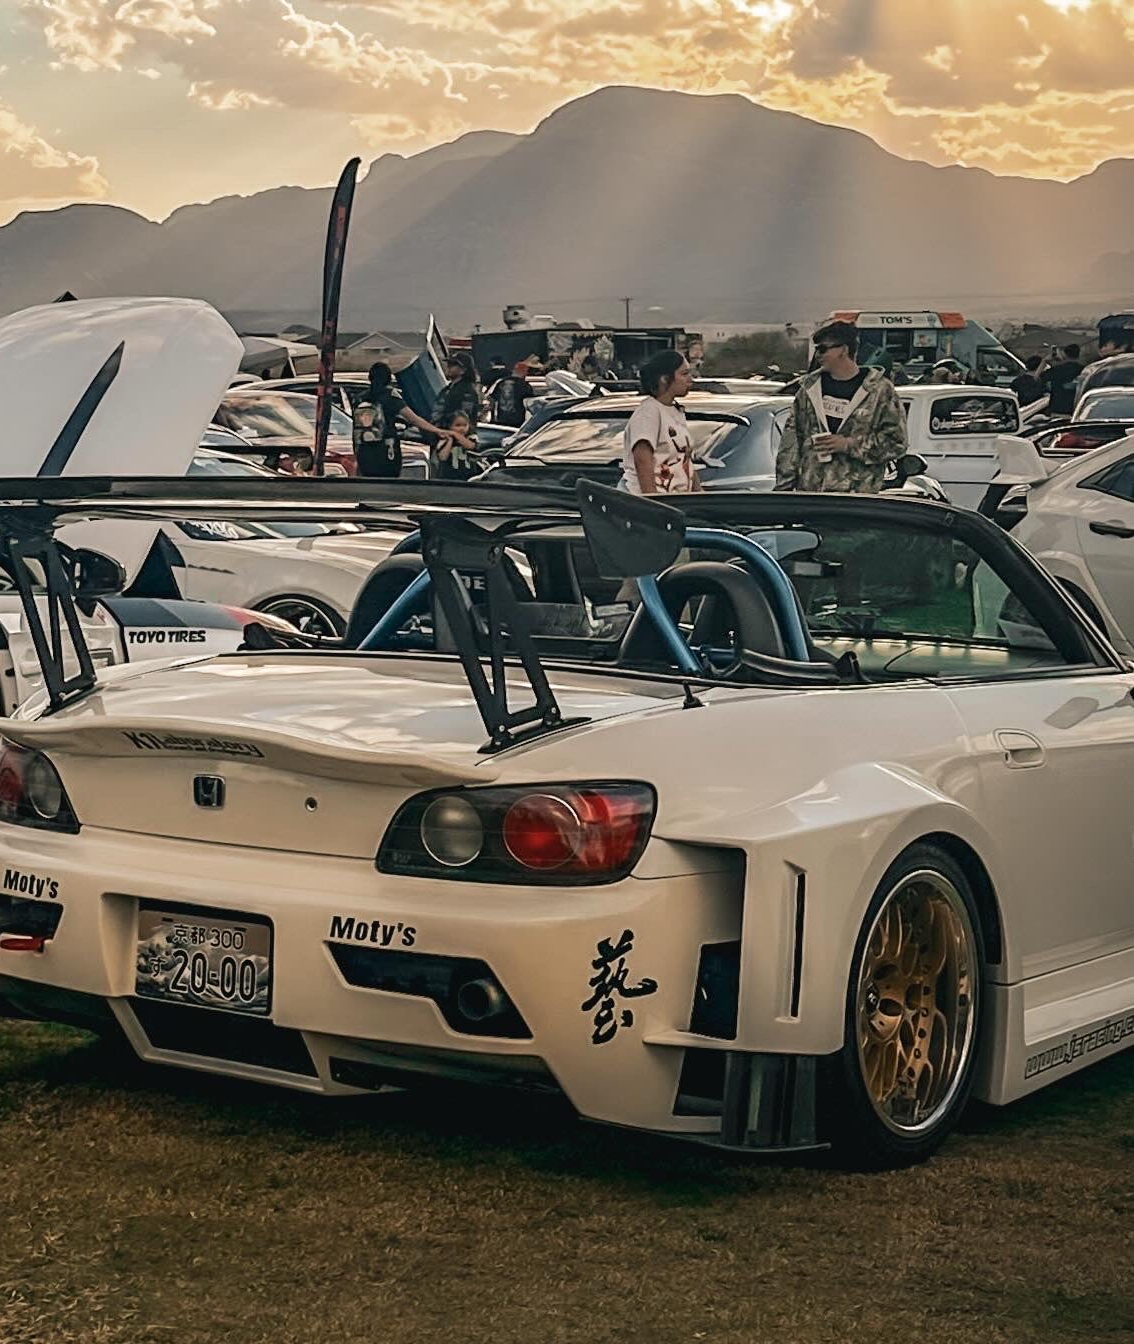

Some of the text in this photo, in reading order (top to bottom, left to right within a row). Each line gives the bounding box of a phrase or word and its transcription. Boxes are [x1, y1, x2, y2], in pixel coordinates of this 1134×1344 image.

[879, 316, 913, 324] TOM'S
[128, 630, 206, 644] TOYO TIRES
[3, 869, 59, 899] Moty's
[172, 924, 245, 950] 京都 300
[329, 915, 417, 947] Moty's
[169, 949, 257, 1003] 20-00
